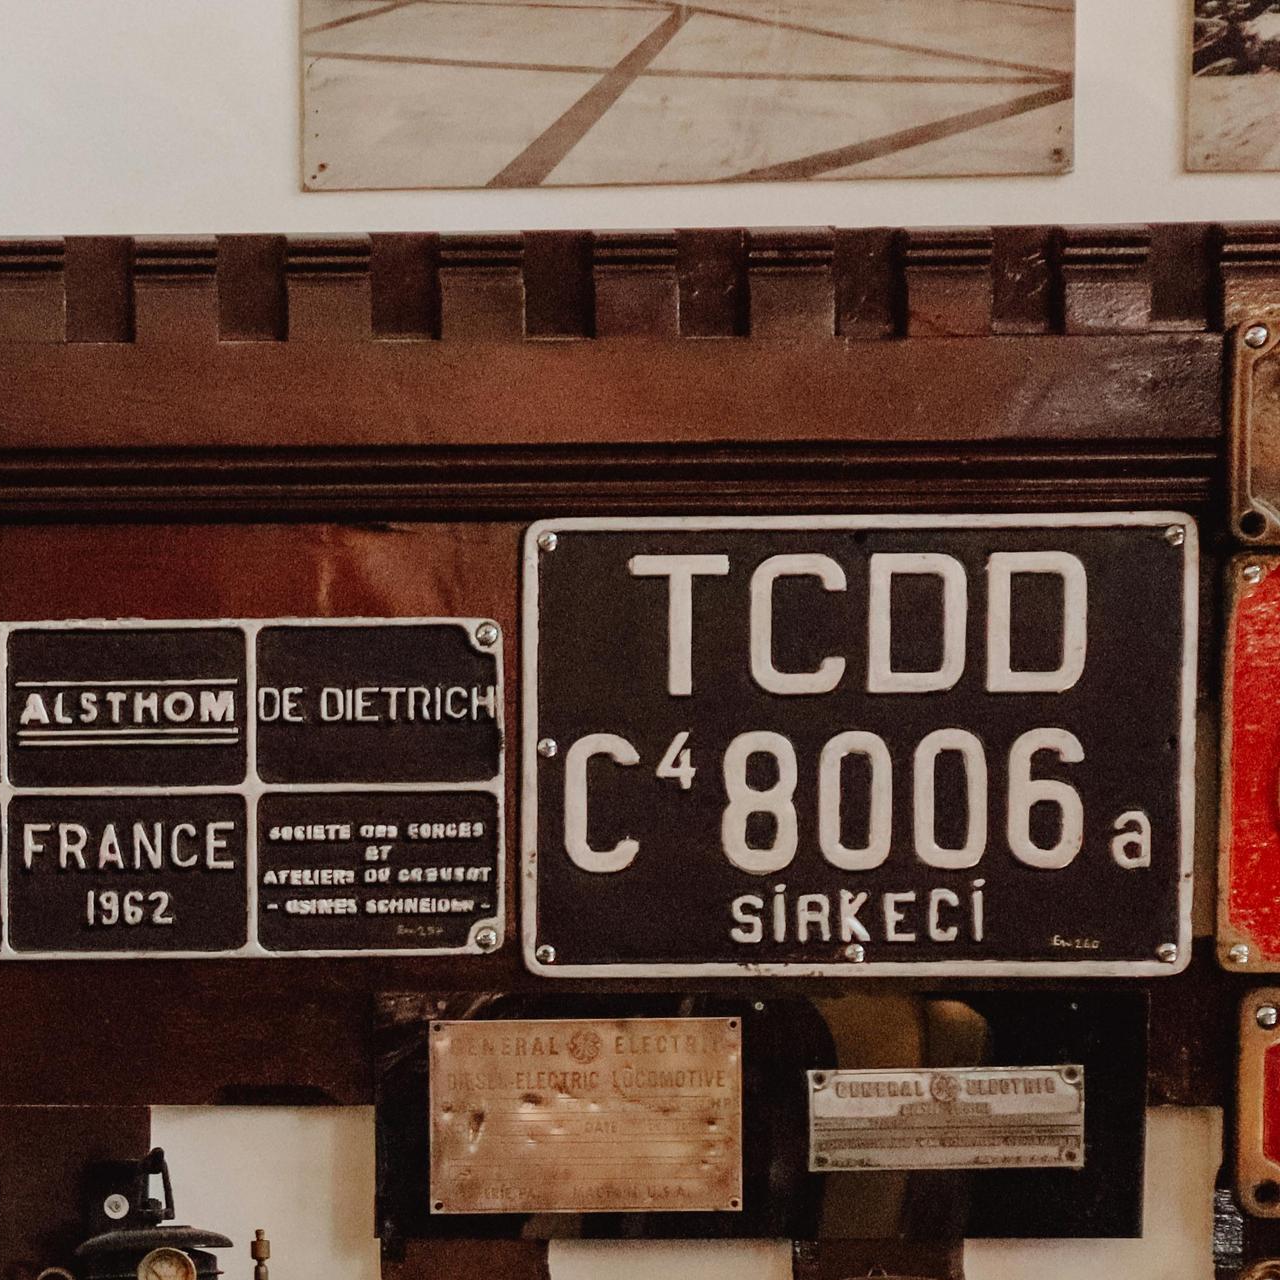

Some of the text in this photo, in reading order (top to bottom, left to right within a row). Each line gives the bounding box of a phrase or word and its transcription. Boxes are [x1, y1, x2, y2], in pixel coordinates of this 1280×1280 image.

[627, 550, 1089, 697] TCDD
[19, 690, 236, 725] ALSTHOM
[257, 684, 496, 723] DE DIETRICH
[22, 820, 236, 870] FRANCE
[268, 824, 352, 841] SOCIETE
[407, 822, 484, 839] FORGES
[364, 845, 393, 861] ET
[263, 869, 355, 885] ATELIERS
[363, 868, 391, 883] DU
[87, 889, 174, 926] 1962
[729, 879, 987, 947] SİRKECİ
[611, 1069, 726, 1090] LOCOMOTIVE
[835, 1077, 1057, 1098] GENERAL ELECTRIC
